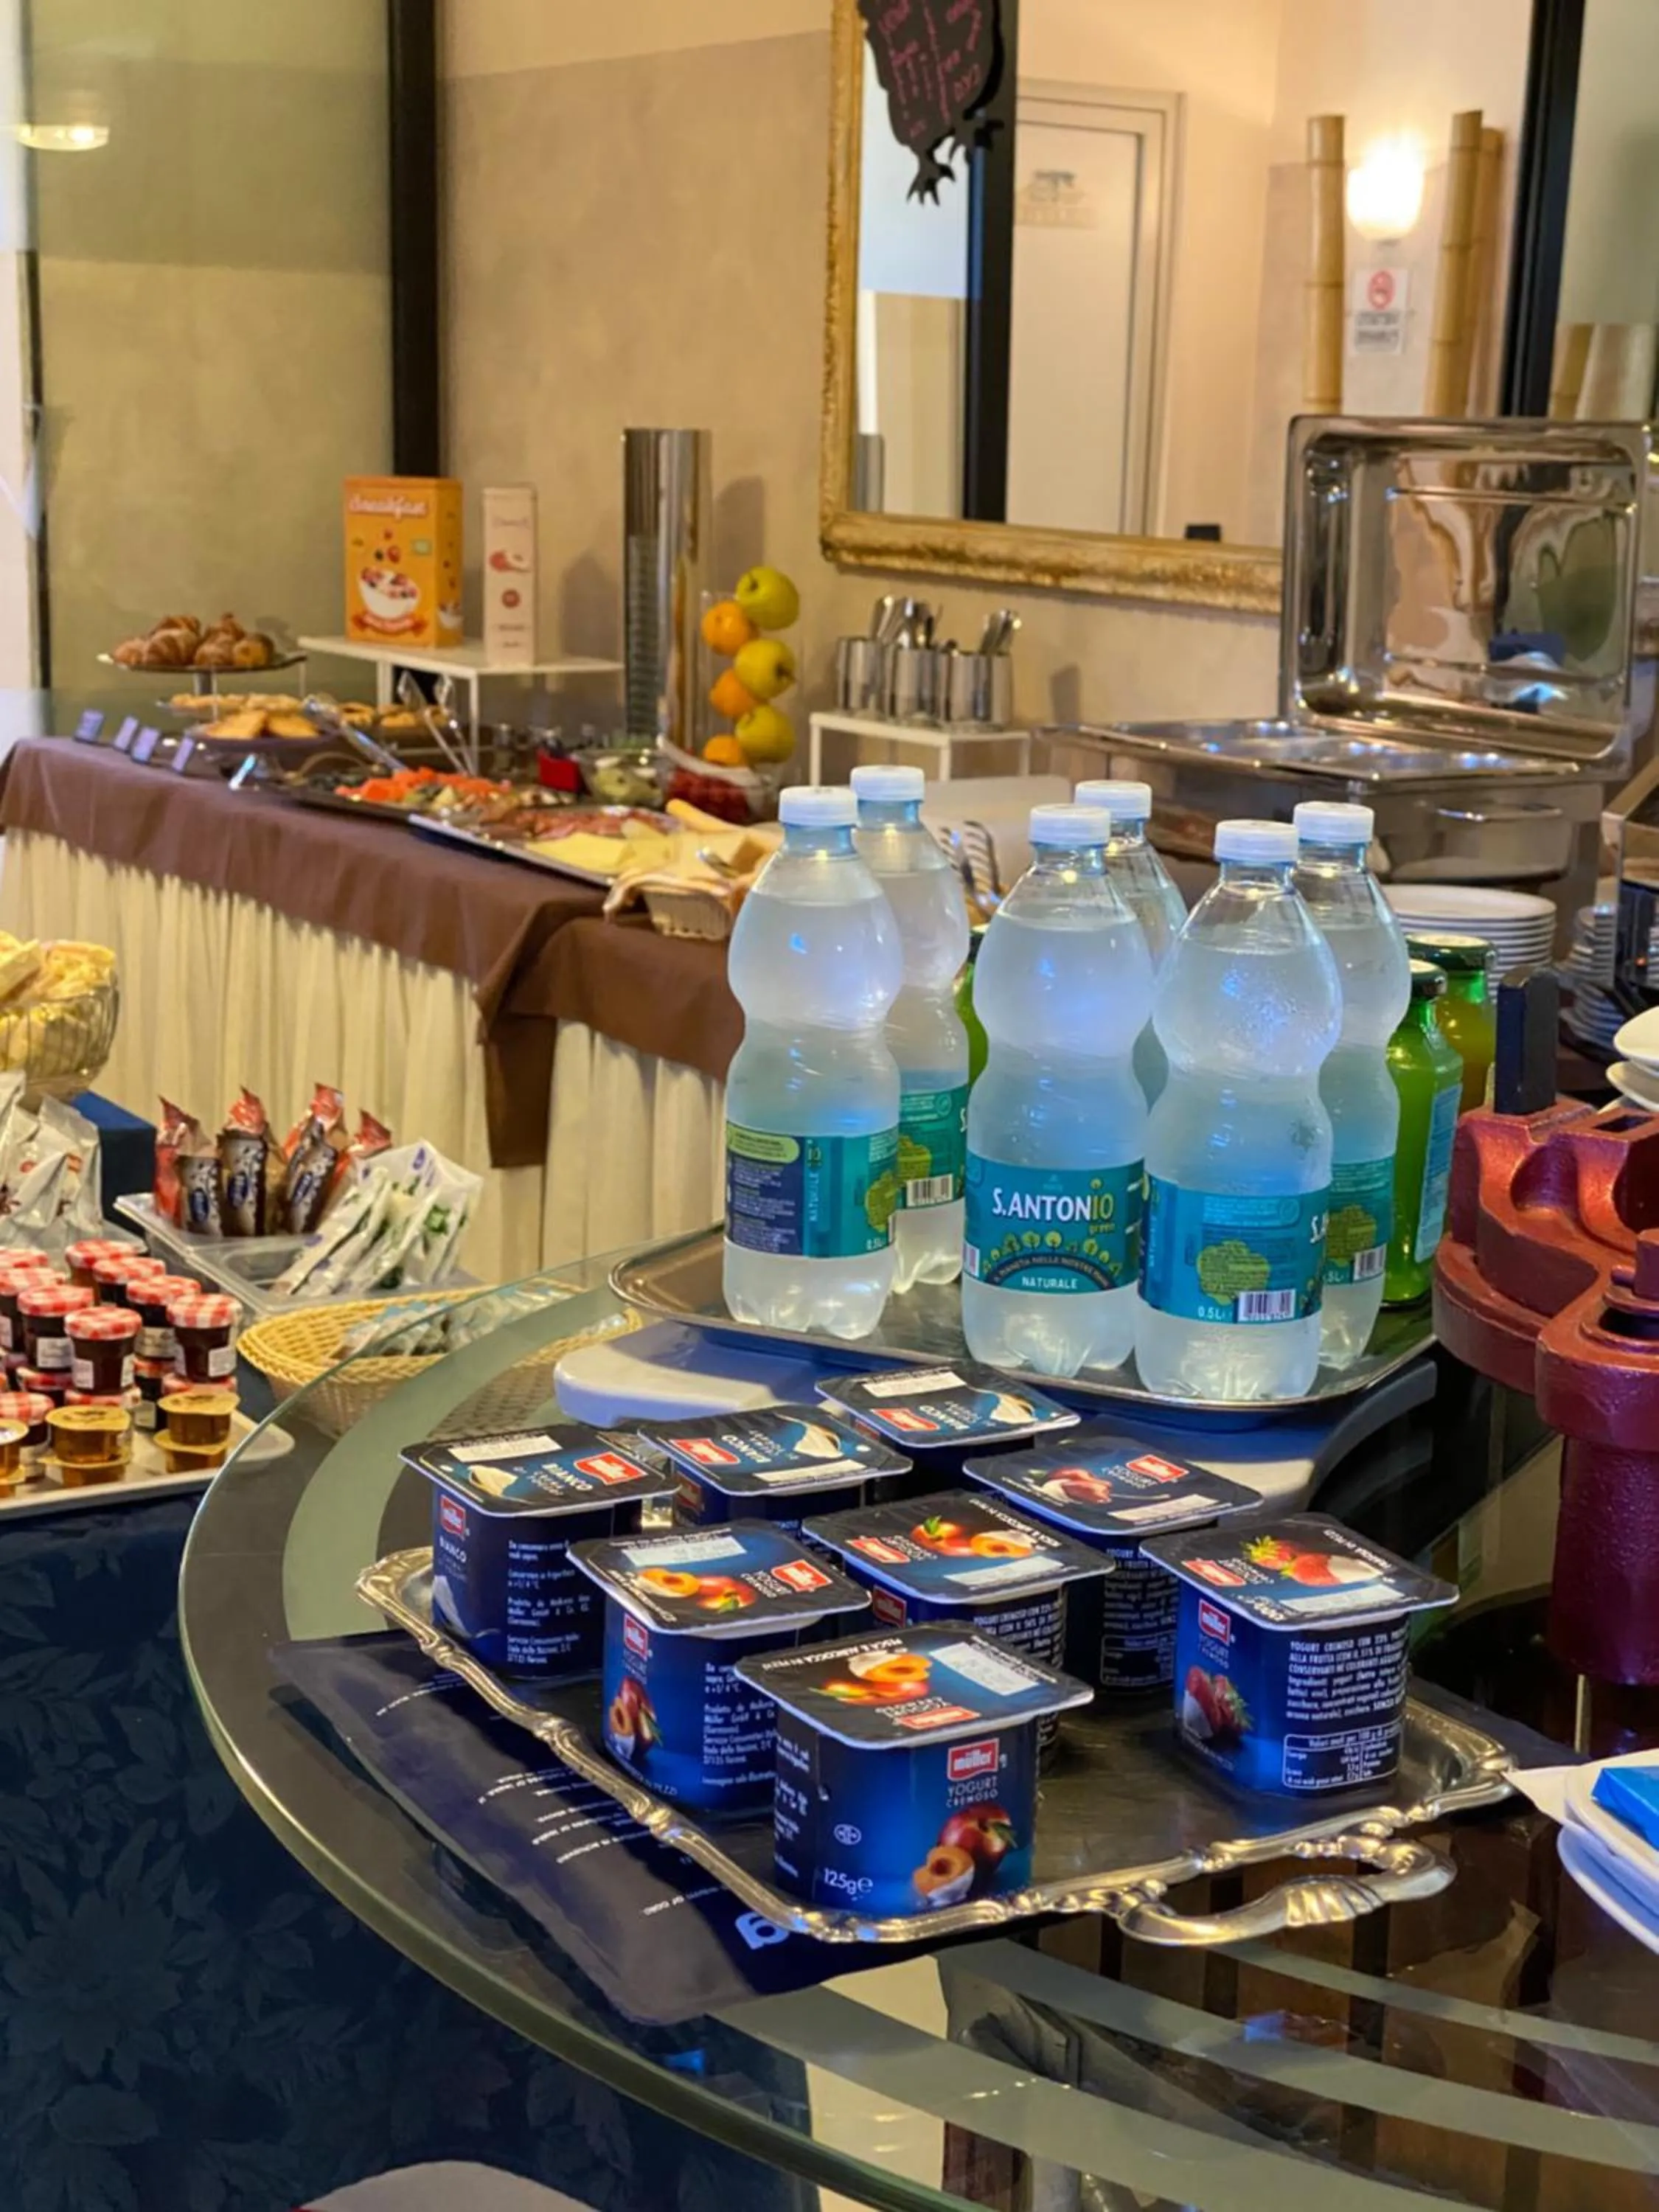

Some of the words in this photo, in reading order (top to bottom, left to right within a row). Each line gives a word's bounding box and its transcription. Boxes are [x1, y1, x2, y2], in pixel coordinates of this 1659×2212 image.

[992, 1186, 1114, 1222] S.ANTONIO
[1021, 1276, 1078, 1290] NATURALE
[953, 1748, 993, 1771] müller
[946, 1788, 998, 1808] CREMOSO
[948, 1776, 998, 1798] YOGURT
